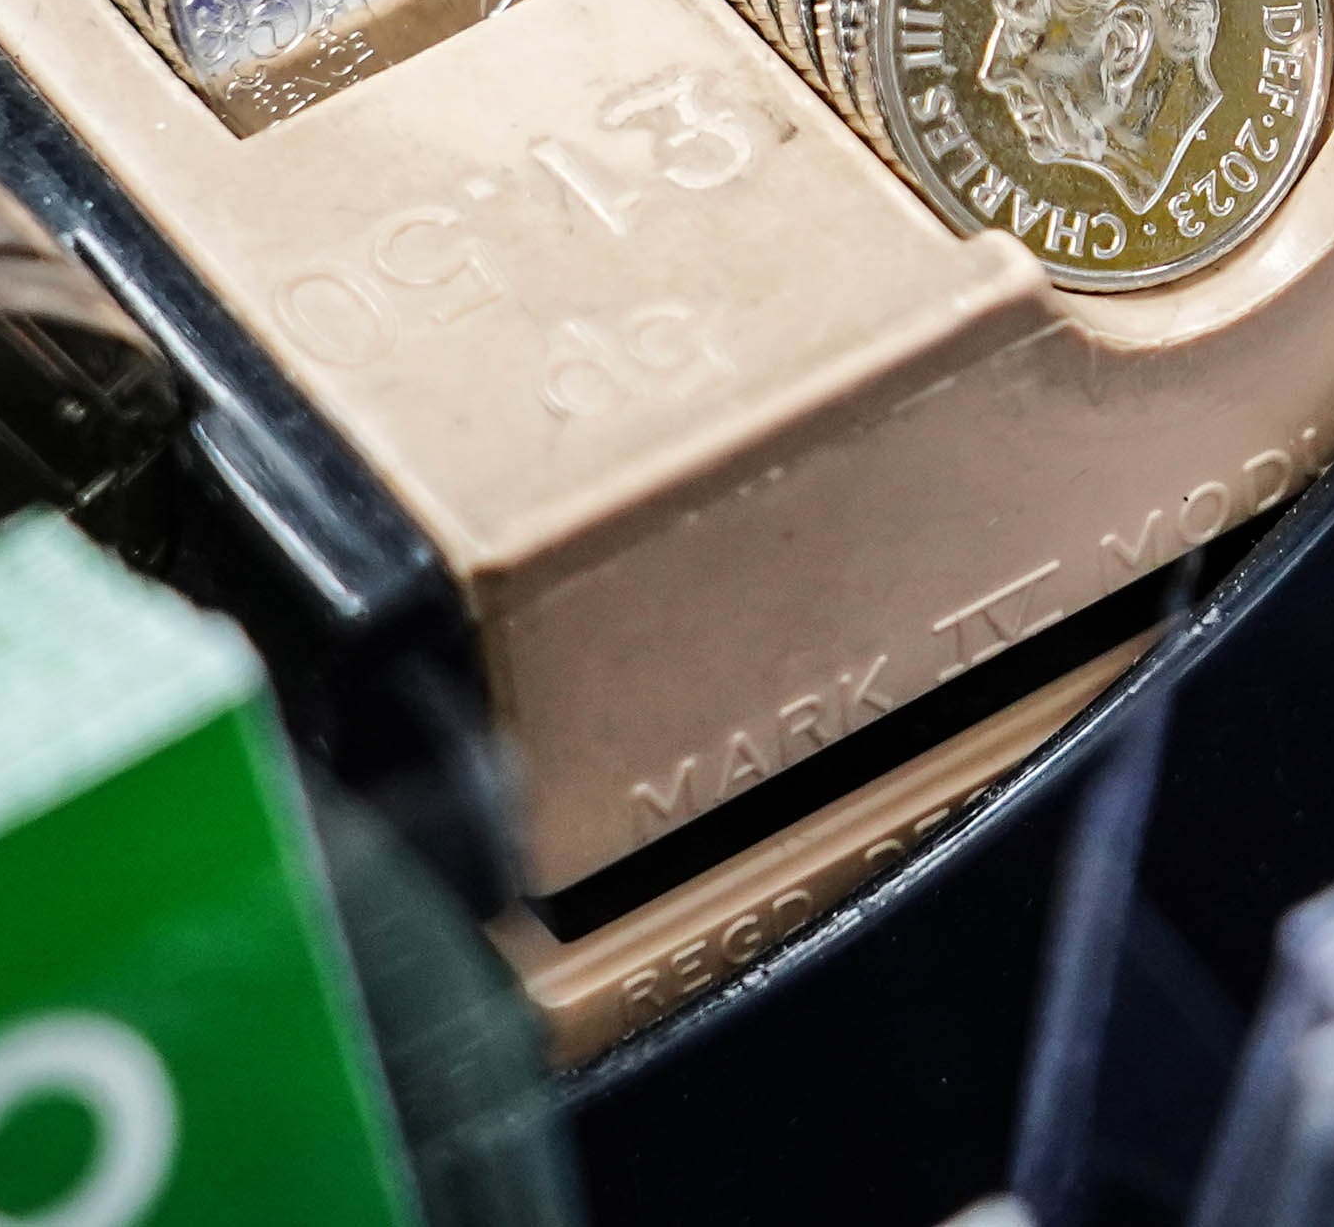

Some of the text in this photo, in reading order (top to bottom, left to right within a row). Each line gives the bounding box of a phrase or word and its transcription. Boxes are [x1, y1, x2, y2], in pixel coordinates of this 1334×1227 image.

[898, 6, 945, 71] III
[1256, 2, 1306, 119] DEF
[272, 73, 753, 370] £1.50
[914, 79, 1129, 260] CHARLES
[1167, 119, 1280, 239] 2023
[540, 301, 739, 419] 5p
[625, 653, 897, 845] MARK
[931, 559, 1067, 681] IV
[615, 885, 817, 1025] REGD
